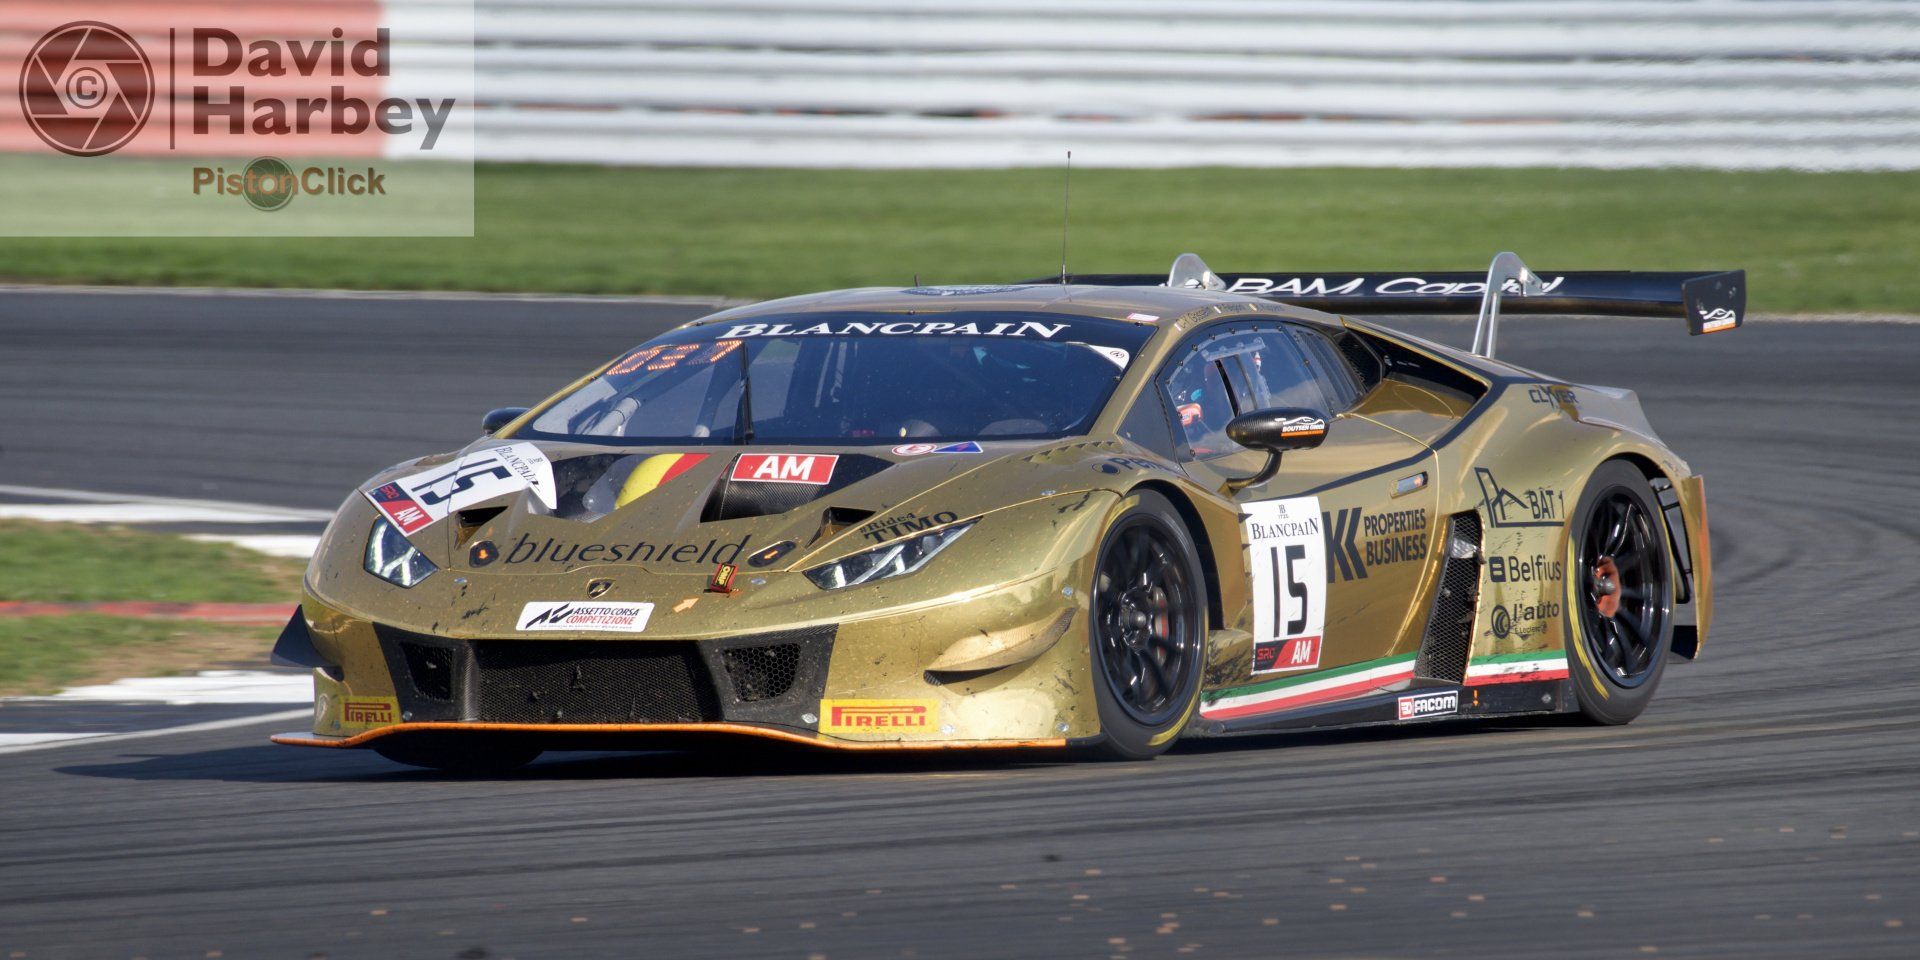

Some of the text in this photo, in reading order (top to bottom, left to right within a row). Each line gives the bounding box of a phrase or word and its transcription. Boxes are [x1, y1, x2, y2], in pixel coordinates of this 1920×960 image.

[1225, 277, 1365, 294] BAM
[716, 322, 1072, 339] BLANCPAIN
[753, 455, 816, 480] AM
[411, 458, 513, 505] 15
[393, 506, 425, 526] AM
[864, 511, 958, 543] TIMO
[1364, 508, 1426, 536] PROPERTIES
[1251, 518, 1318, 539] BLANCPAIN
[503, 533, 752, 565] blueshield
[1366, 533, 1427, 566] BUSINESS
[1508, 554, 1562, 582] Belfius
[1270, 544, 1309, 638] 15
[565, 615, 636, 625] COMPETIZIONE
[573, 607, 640, 616] ASSETTO CORSA
[1291, 639, 1312, 664] AM
[344, 702, 393, 723] PIRELLI
[1414, 695, 1456, 713] FACOM
[831, 706, 927, 726] PIRELLI
